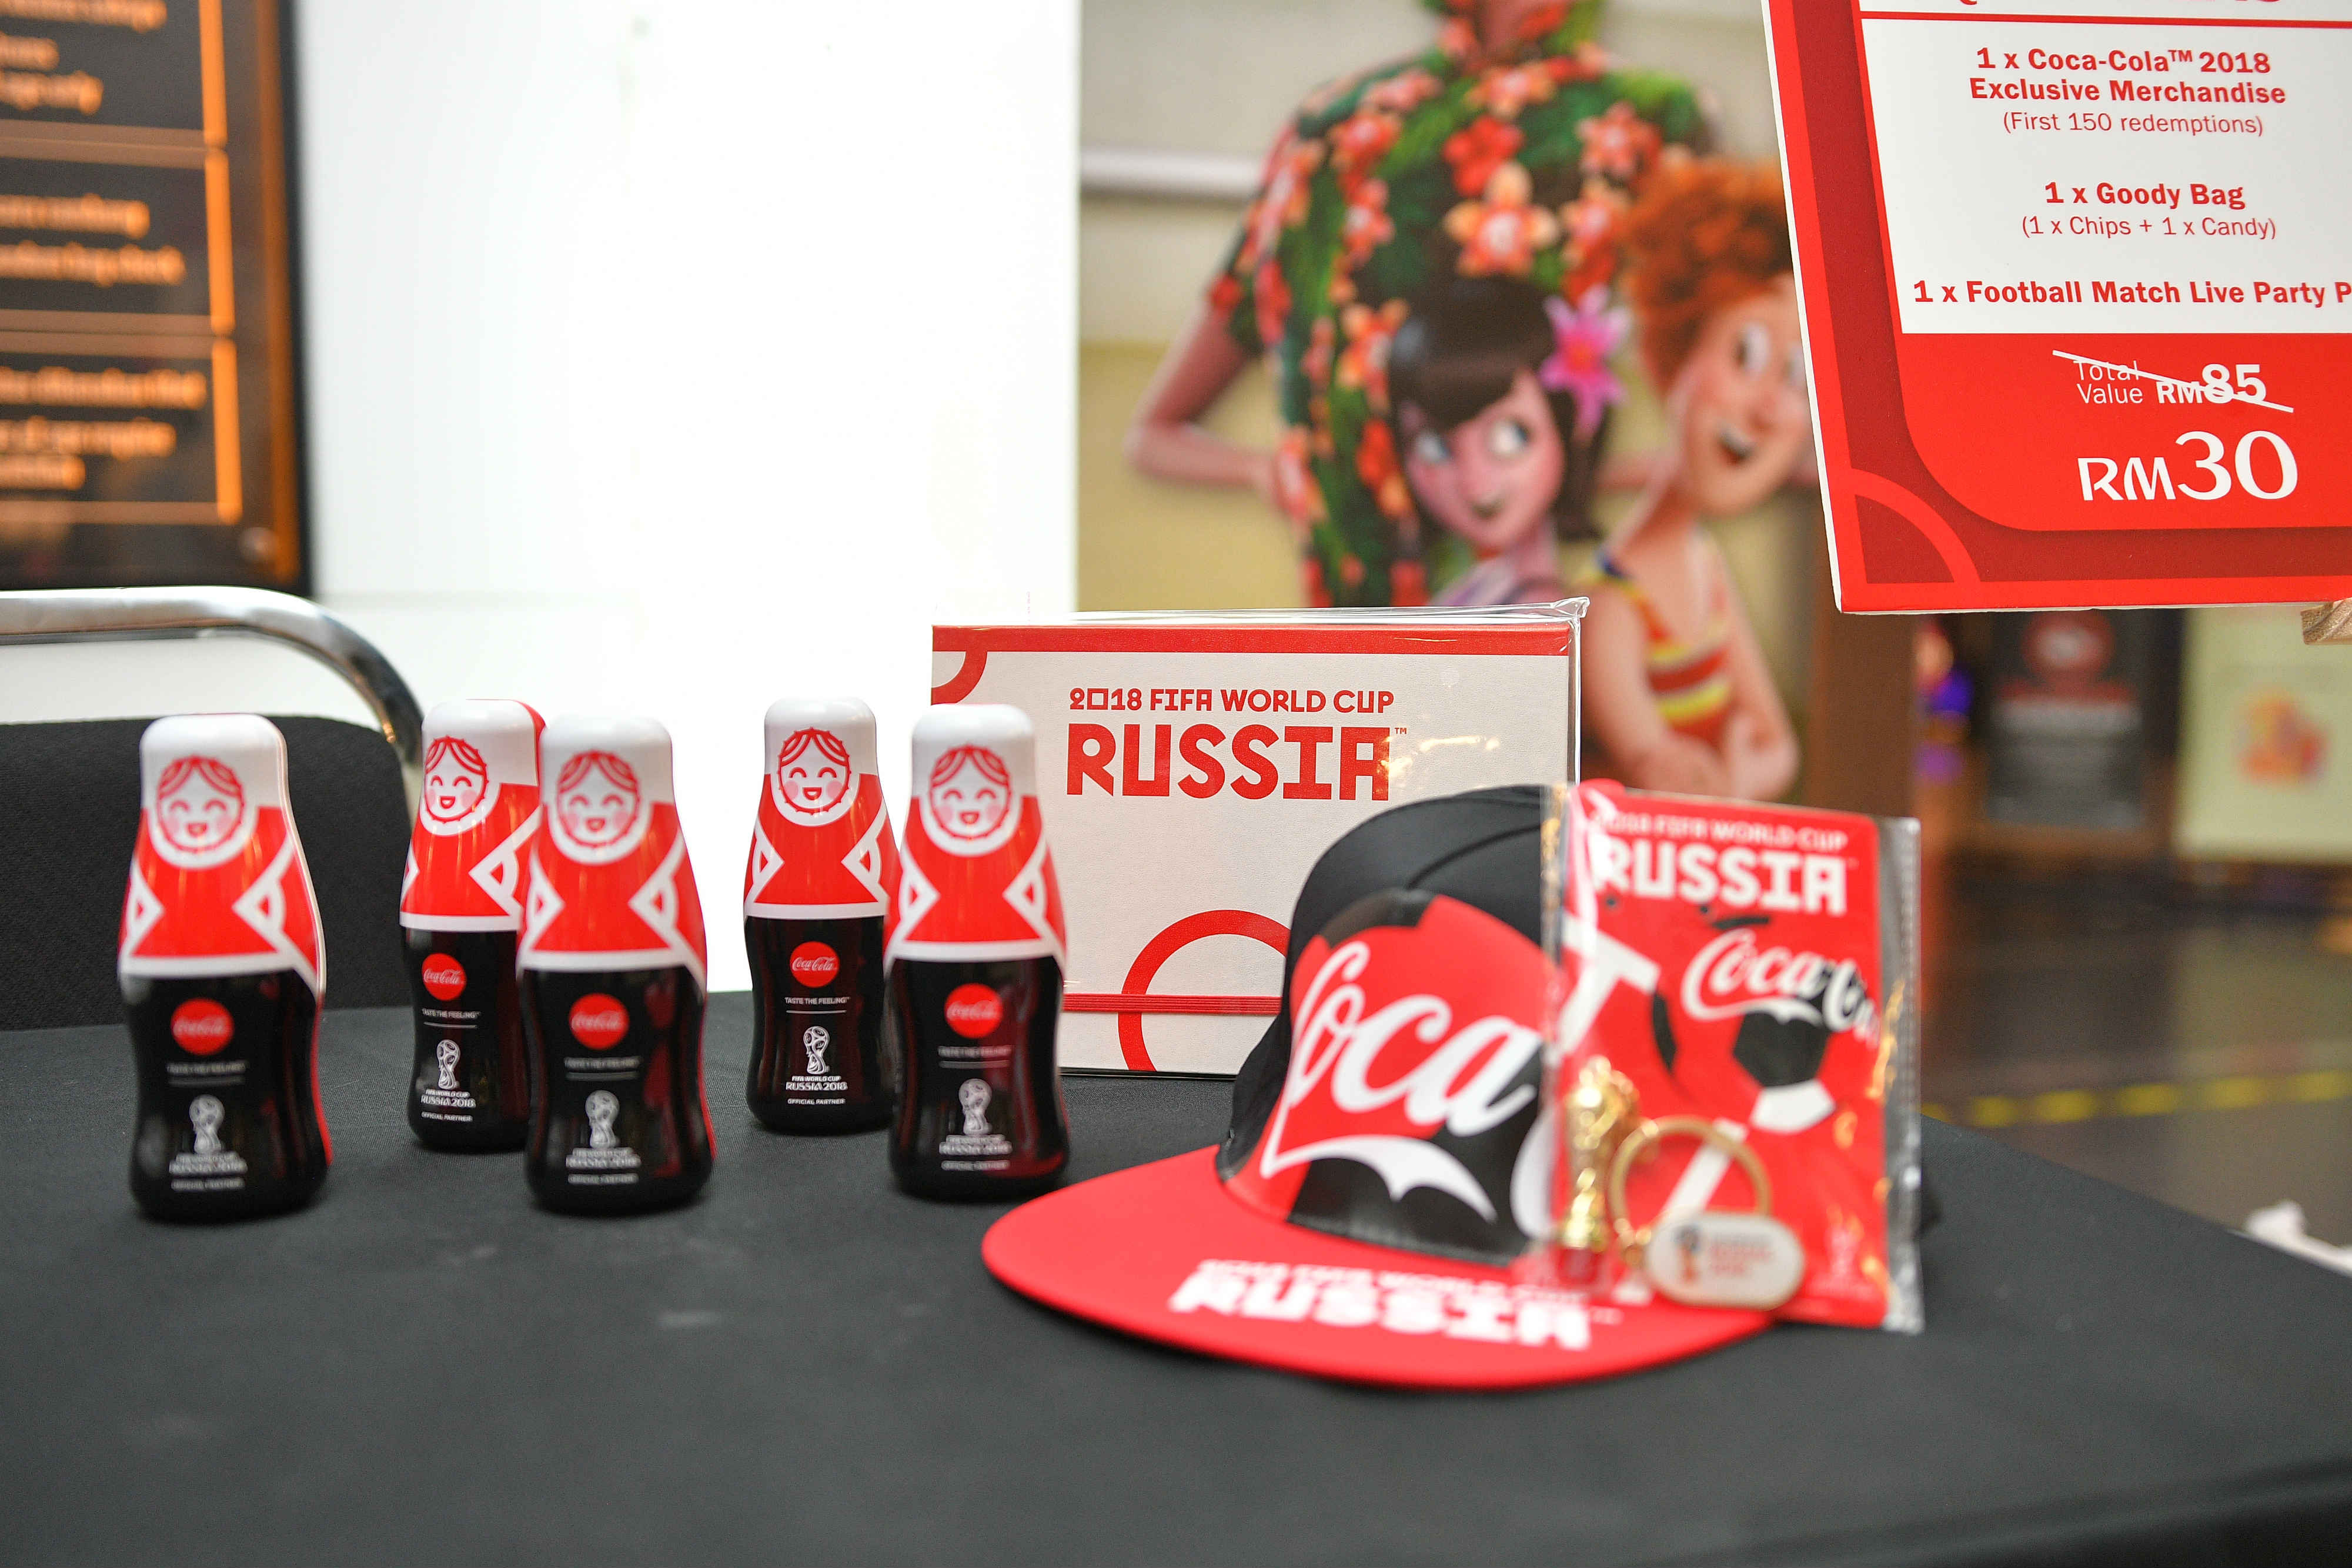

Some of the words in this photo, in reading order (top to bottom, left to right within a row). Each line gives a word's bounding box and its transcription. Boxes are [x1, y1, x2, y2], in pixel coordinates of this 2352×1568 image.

[1977, 47, 1996, 69] 1
[2003, 53, 2020, 69] x
[2199, 52, 2271, 73] 2018
[1970, 77, 2100, 100] Exclusive
[2109, 79, 2286, 104] Merchandise
[2003, 112, 2061, 134] (First
[2068, 112, 2112, 131] 150
[2120, 114, 2263, 137] redemptions)
[2044, 181, 2064, 203] 1
[2072, 186, 2089, 203] x
[2096, 182, 2181, 209] Goody
[2190, 183, 2247, 210] Bag
[2022, 215, 2044, 238] (1
[2050, 219, 2063, 235] x
[2069, 216, 2132, 239] Chips
[2162, 216, 2177, 235] 1
[2183, 221, 2195, 235] x
[2201, 217, 2277, 240] Candy)
[1913, 280, 1934, 303] 1
[1941, 286, 1959, 303] x
[1966, 280, 2083, 303] Football
[2091, 280, 2181, 303] Match
[2189, 281, 2244, 303] Live
[2253, 282, 2325, 308] Party
[2073, 359, 2140, 381] Total
[2076, 383, 2144, 404] Value
[2156, 363, 2267, 404] RM85
[2077, 430, 2298, 501] RM30
[1069, 687, 1142, 711] 2018
[1150, 688, 1212, 711] FIFA
[1220, 689, 1327, 713] WORLD
[1333, 690, 1395, 713] CUP
[1710, 819, 1795, 848] WORLD
[1796, 826, 1849, 852] CUP
[1590, 833, 1847, 916] RUSSIA
[786, 1082, 823, 1091] RUSSIA
[823, 1082, 848, 1091] 2018
[420, 1094, 452, 1106] RUSSIA
